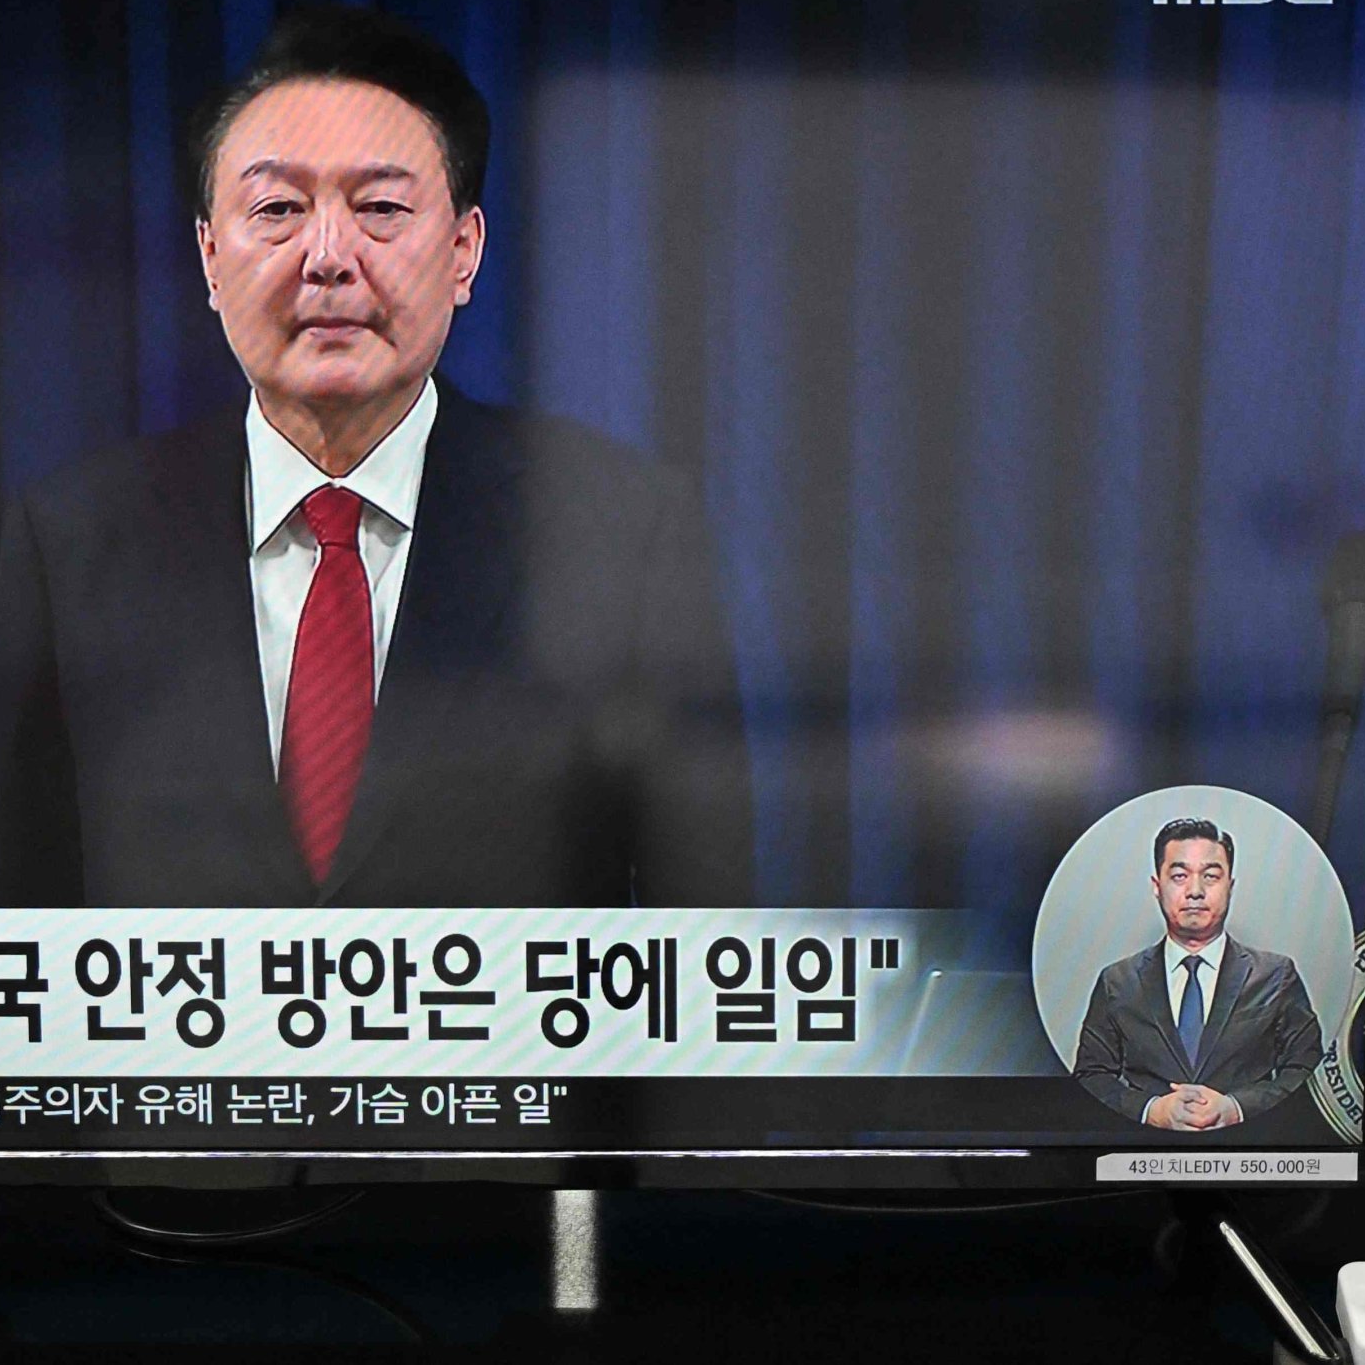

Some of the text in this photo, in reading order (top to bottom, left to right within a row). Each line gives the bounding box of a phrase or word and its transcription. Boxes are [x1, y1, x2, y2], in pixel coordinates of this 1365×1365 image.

[75, 937, 227, 1049] 안정
[261, 933, 496, 1048] 방안은
[524, 935, 679, 1048] 당에
[705, 935, 900, 1043] 일임"
[135, 1084, 215, 1125] 유해
[226, 1084, 317, 1126] 논란,
[328, 1084, 408, 1126] 가슴
[420, 1084, 502, 1126] 아픈
[512, 1084, 568, 1126] 일"
